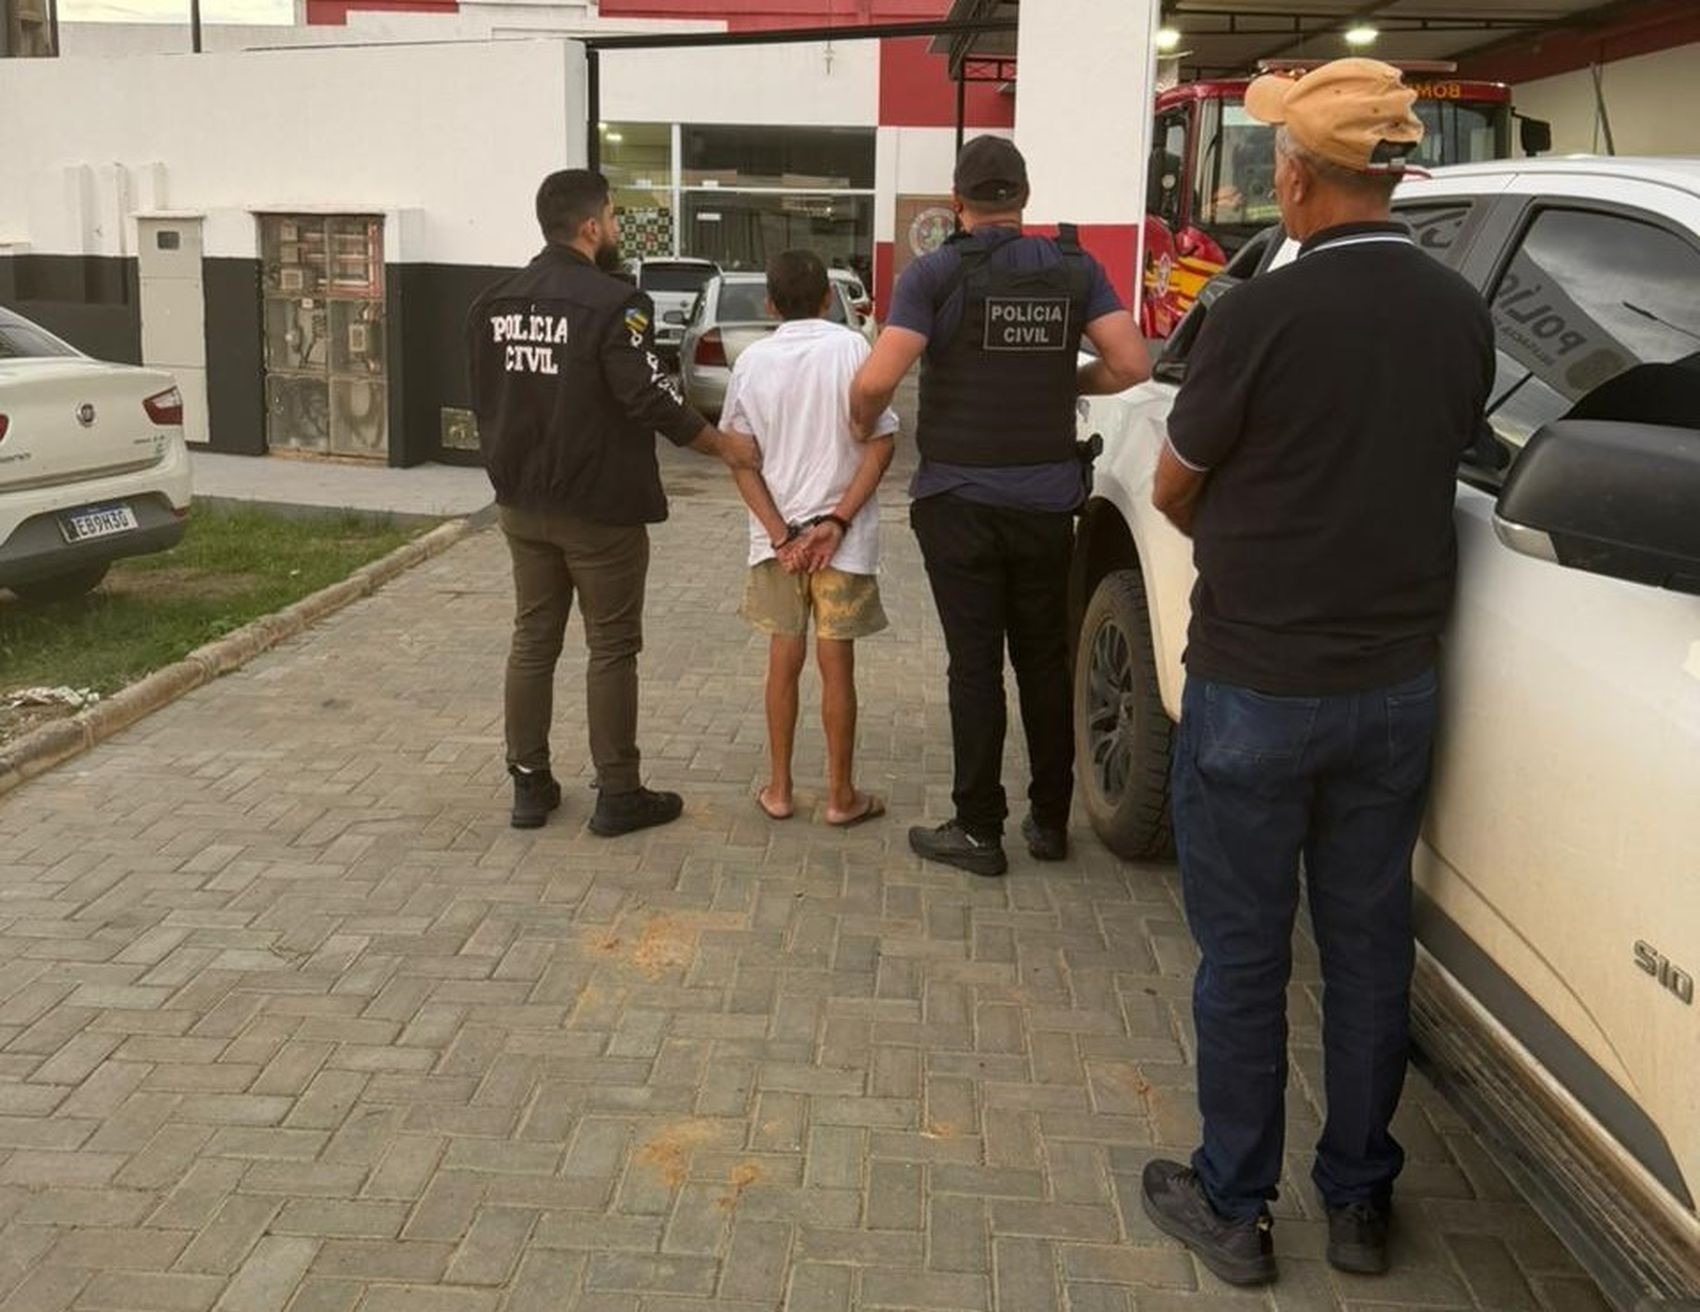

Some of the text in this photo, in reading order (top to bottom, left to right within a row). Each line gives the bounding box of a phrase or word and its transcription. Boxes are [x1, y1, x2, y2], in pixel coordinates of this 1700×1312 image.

[490, 304, 568, 344] POLÍCIA
[991, 302, 1063, 321] POLÍCIA
[1003, 326, 1049, 343] CIVIL
[505, 345, 559, 375] CIVIL
[1634, 939, 1694, 1006] S10
